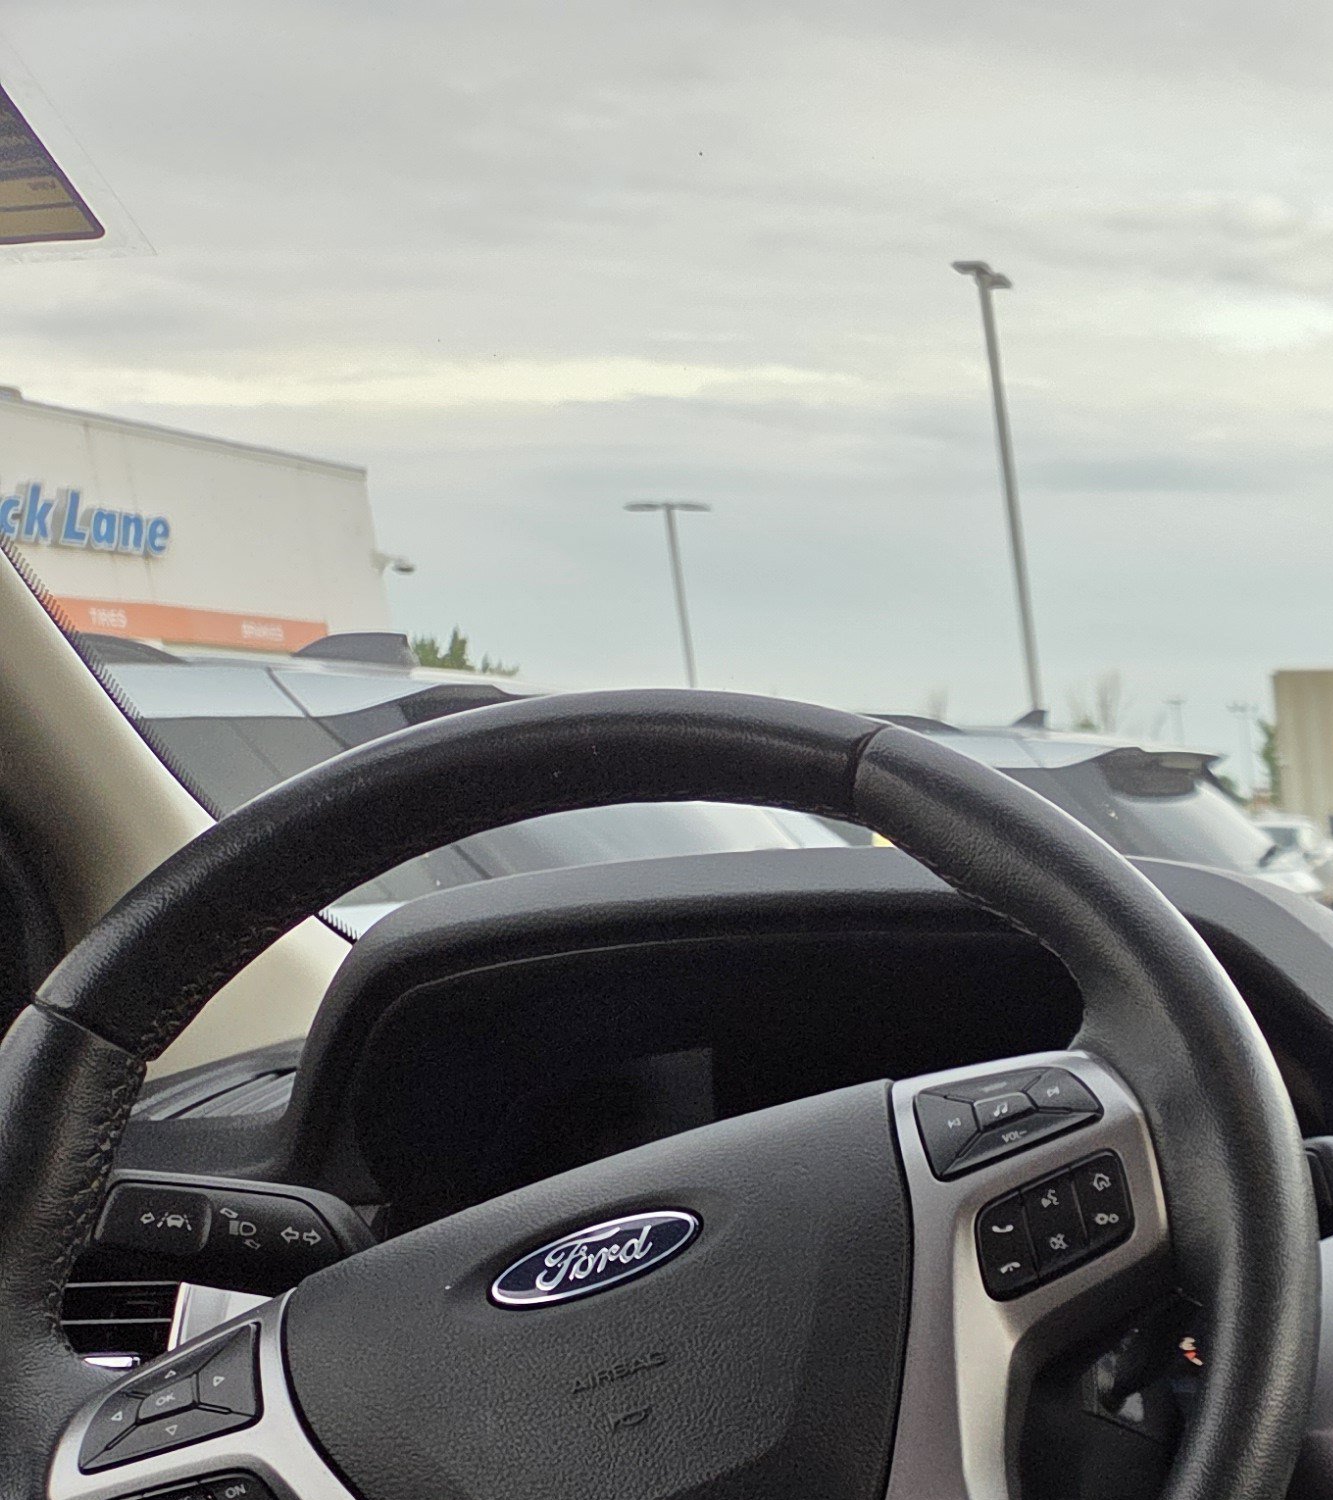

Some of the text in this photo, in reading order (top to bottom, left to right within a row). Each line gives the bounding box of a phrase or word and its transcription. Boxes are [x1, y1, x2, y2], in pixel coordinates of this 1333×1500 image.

[60, 489, 171, 555] Lane
[536, 1224, 653, 1291] Ford
[155, 1392, 176, 1406] OK
[224, 1484, 246, 1499] ON
